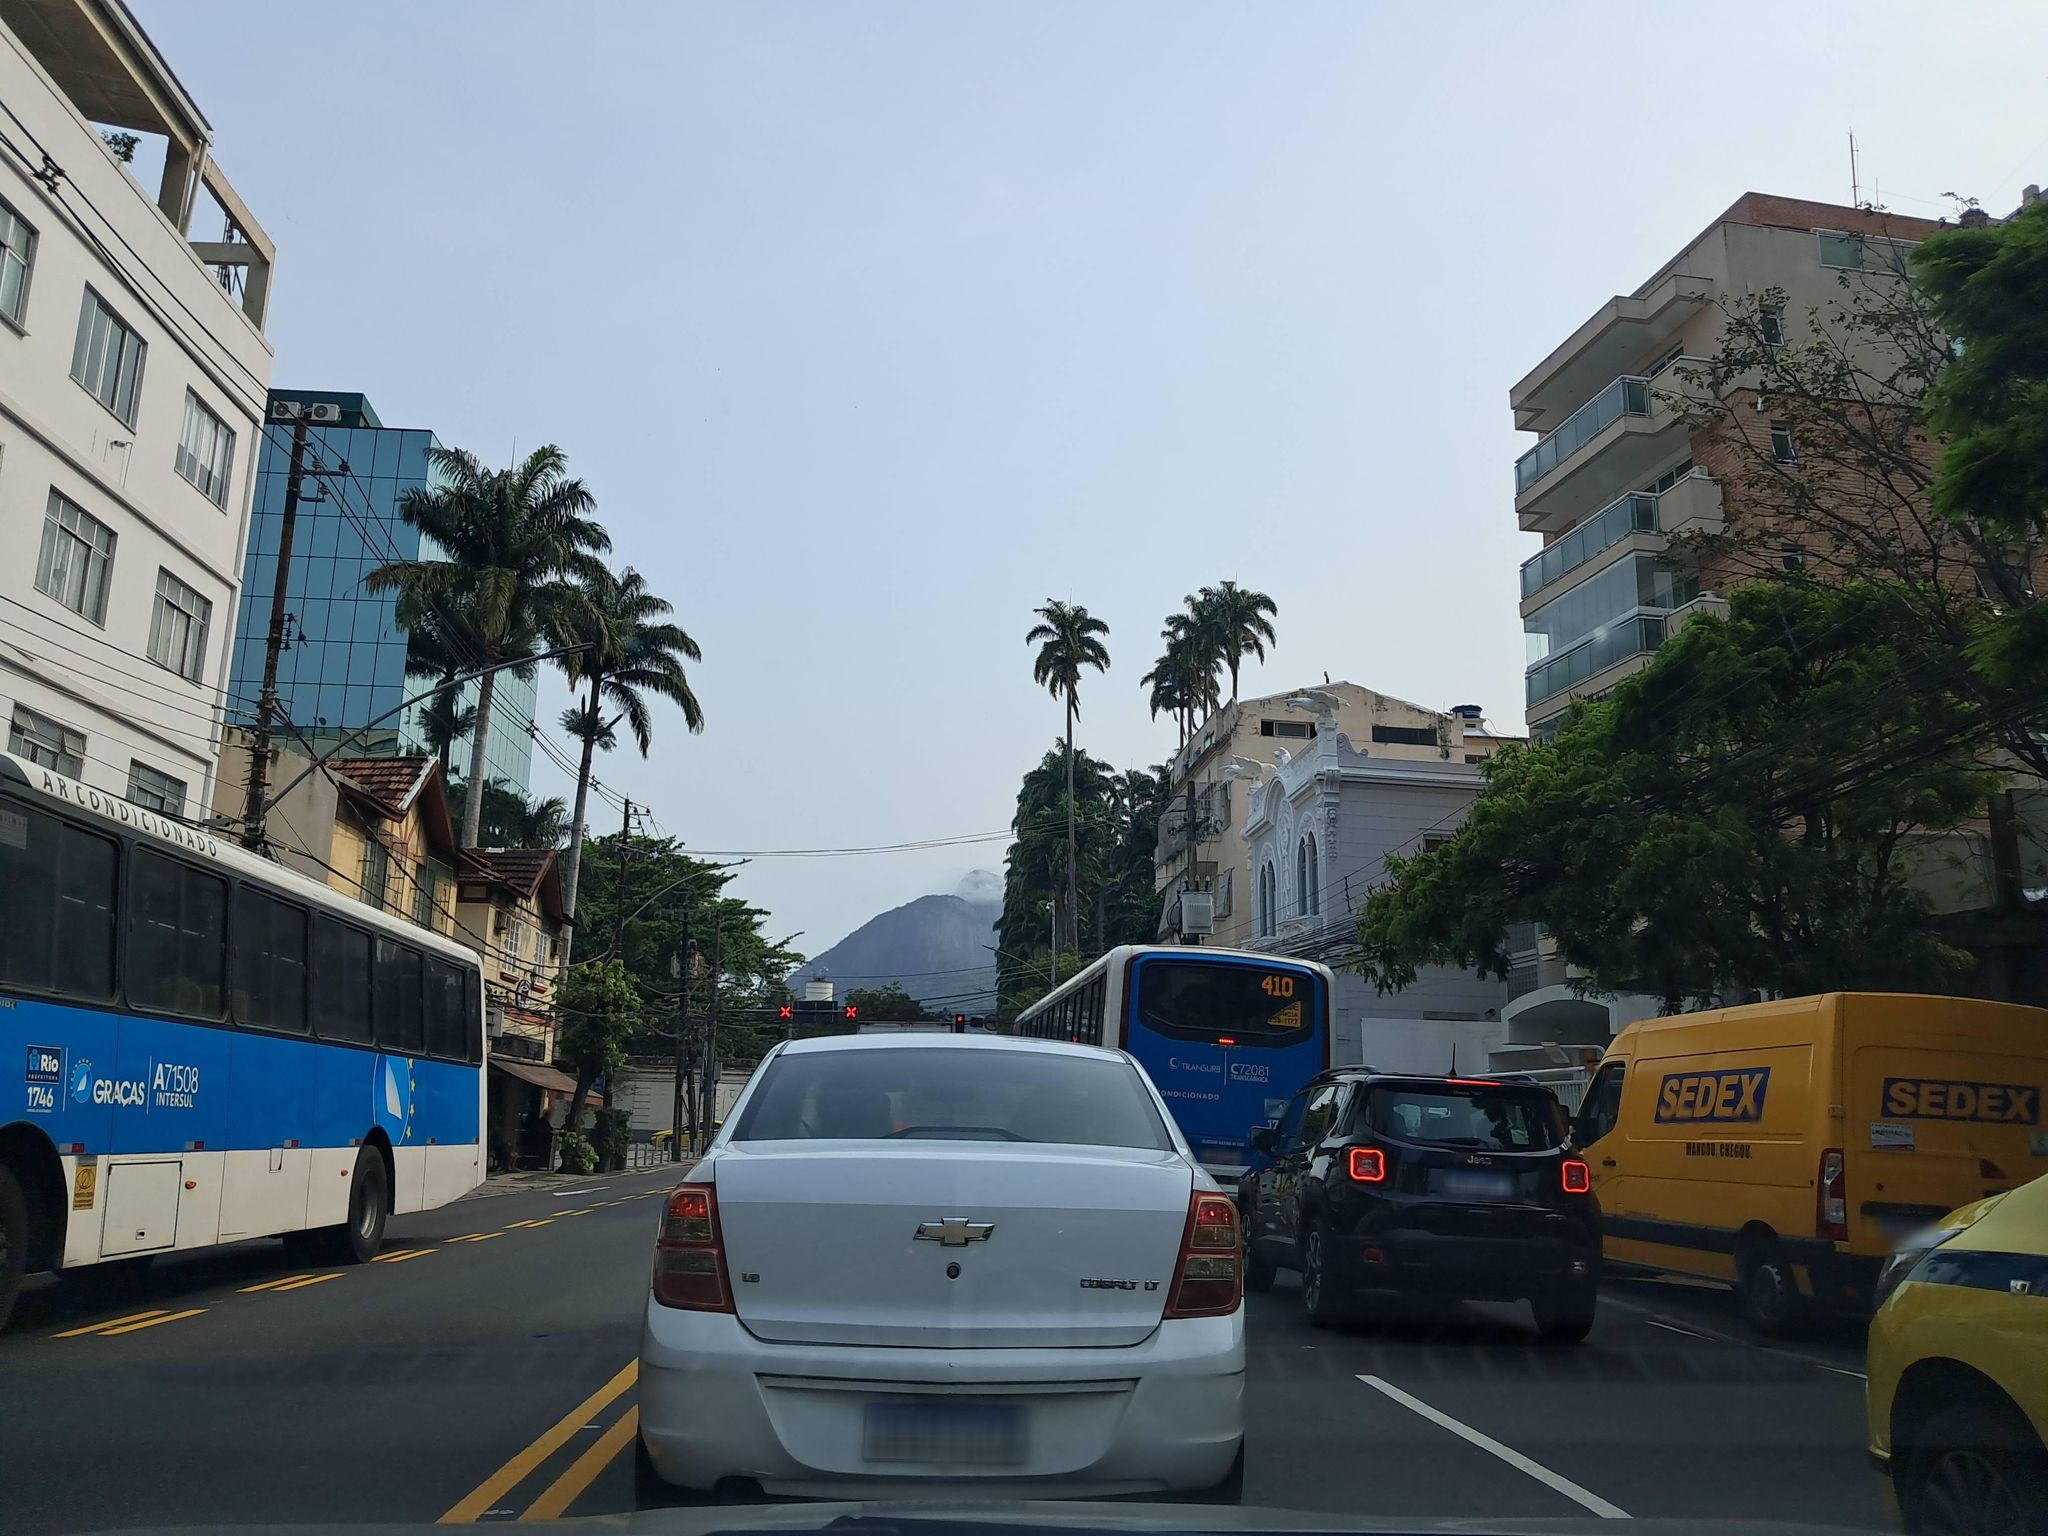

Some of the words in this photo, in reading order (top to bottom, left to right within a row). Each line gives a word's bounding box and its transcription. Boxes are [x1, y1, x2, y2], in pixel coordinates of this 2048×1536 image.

[77, 787, 217, 857] CONDICIONADO
[1261, 975, 1295, 998] 410
[40, 1054, 59, 1073] Rio
[1181, 1062, 1221, 1073] TRANSURB
[1230, 1063, 1269, 1077] C72081
[152, 1063, 199, 1095] A71508
[27, 1086, 54, 1108] 1746
[93, 1078, 146, 1108] GRAÇAS
[155, 1091, 194, 1108] INTERSUL
[1659, 1072, 1764, 1119] SEDEX
[1886, 1081, 2033, 1122] SEDEX
[1080, 1277, 1140, 1291] COBALT
[1144, 1279, 1161, 1292] LT
